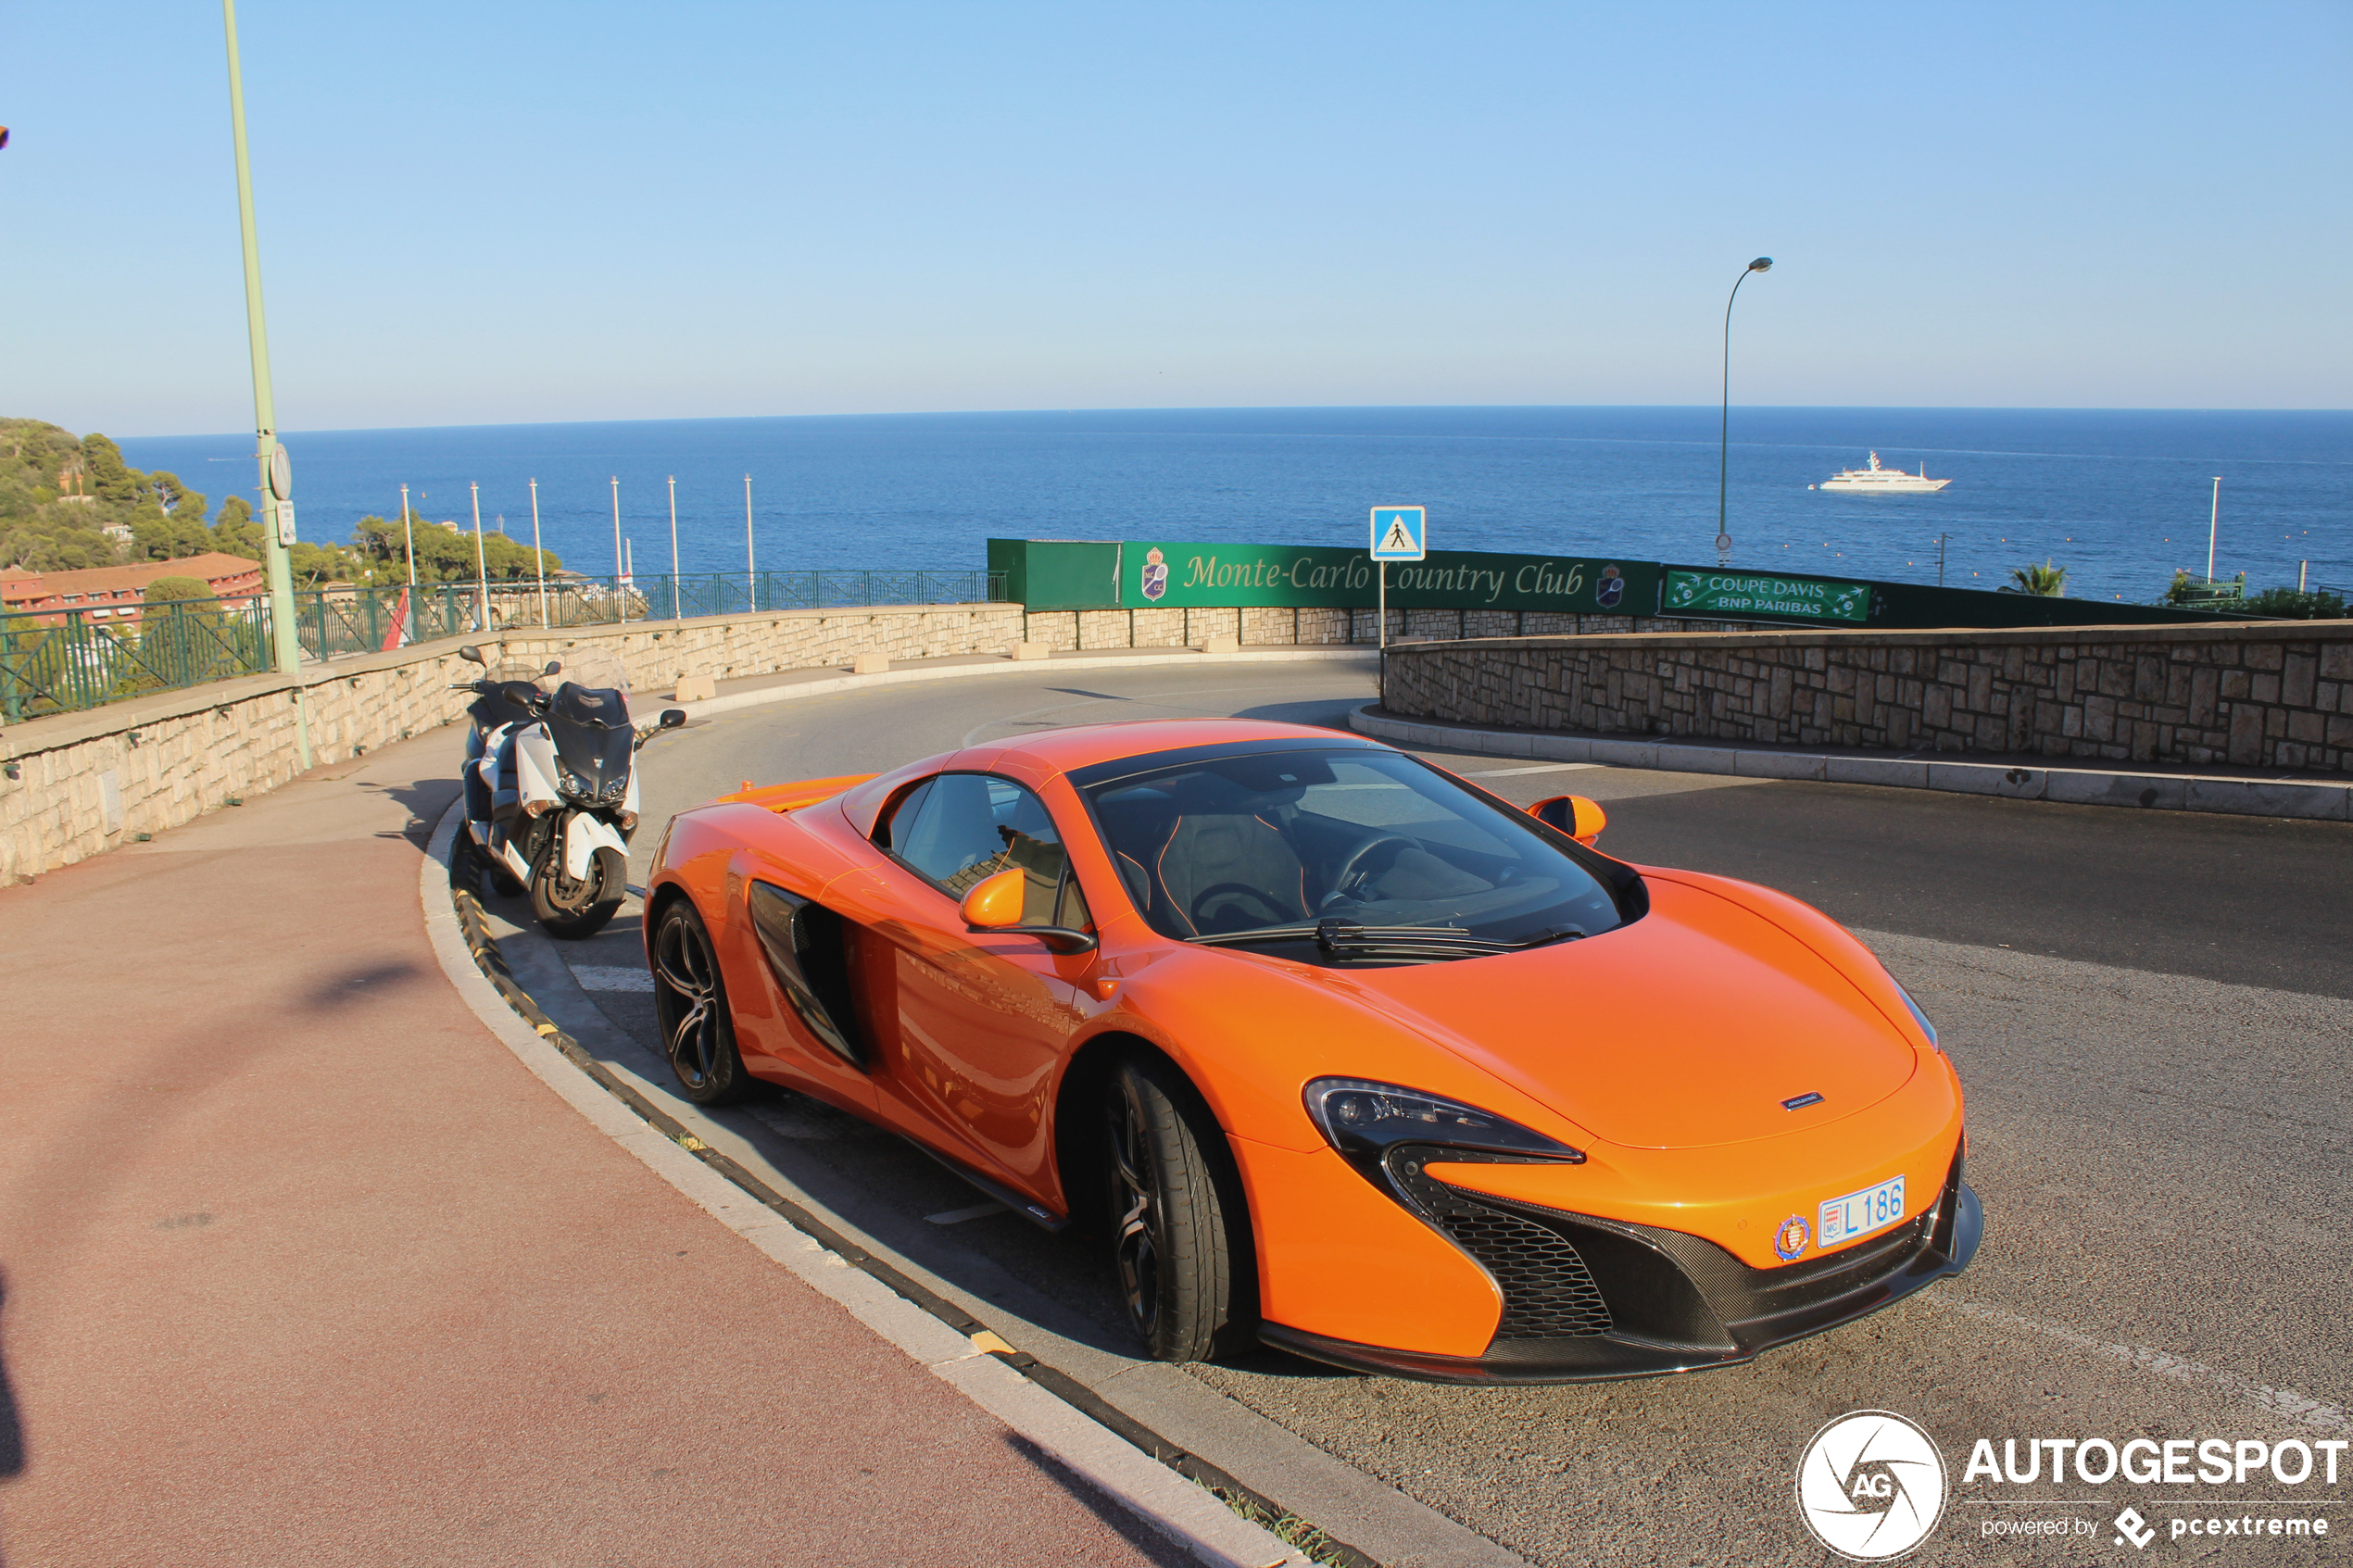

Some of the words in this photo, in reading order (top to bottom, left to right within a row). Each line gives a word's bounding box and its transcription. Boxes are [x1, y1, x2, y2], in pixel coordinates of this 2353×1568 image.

[1183, 554, 1370, 589] Monte-Carlo
[1515, 562, 1584, 595] Club
[1709, 577, 1769, 594] COUPE
[1773, 582, 1825, 598] DAVIS
[1718, 596, 1752, 608] BNP
[1754, 599, 1822, 614] PARIBAS
[1826, 1222, 1838, 1234] MC
